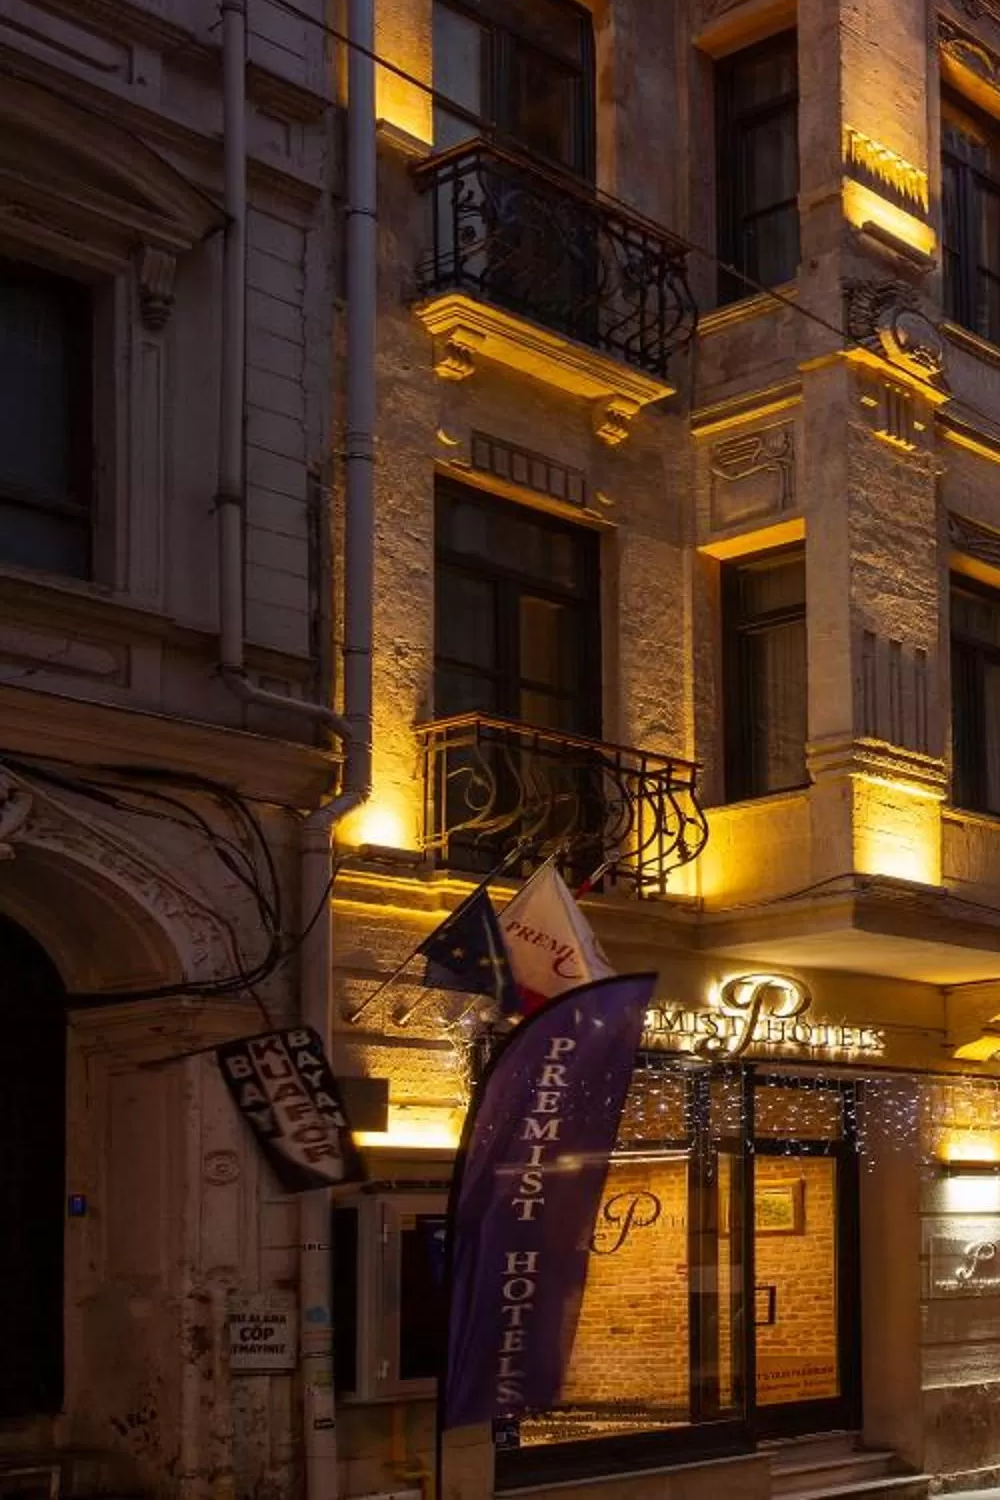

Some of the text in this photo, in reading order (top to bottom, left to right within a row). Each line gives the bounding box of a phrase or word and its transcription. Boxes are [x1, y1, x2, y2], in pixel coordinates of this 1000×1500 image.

[644, 1009, 739, 1037] MIST
[766, 1018, 886, 1050] HOTELS
[224, 1054, 274, 1133] BAY
[287, 1030, 346, 1127] BAYAN
[496, 1036, 575, 1405] PREMIST HOTELS
